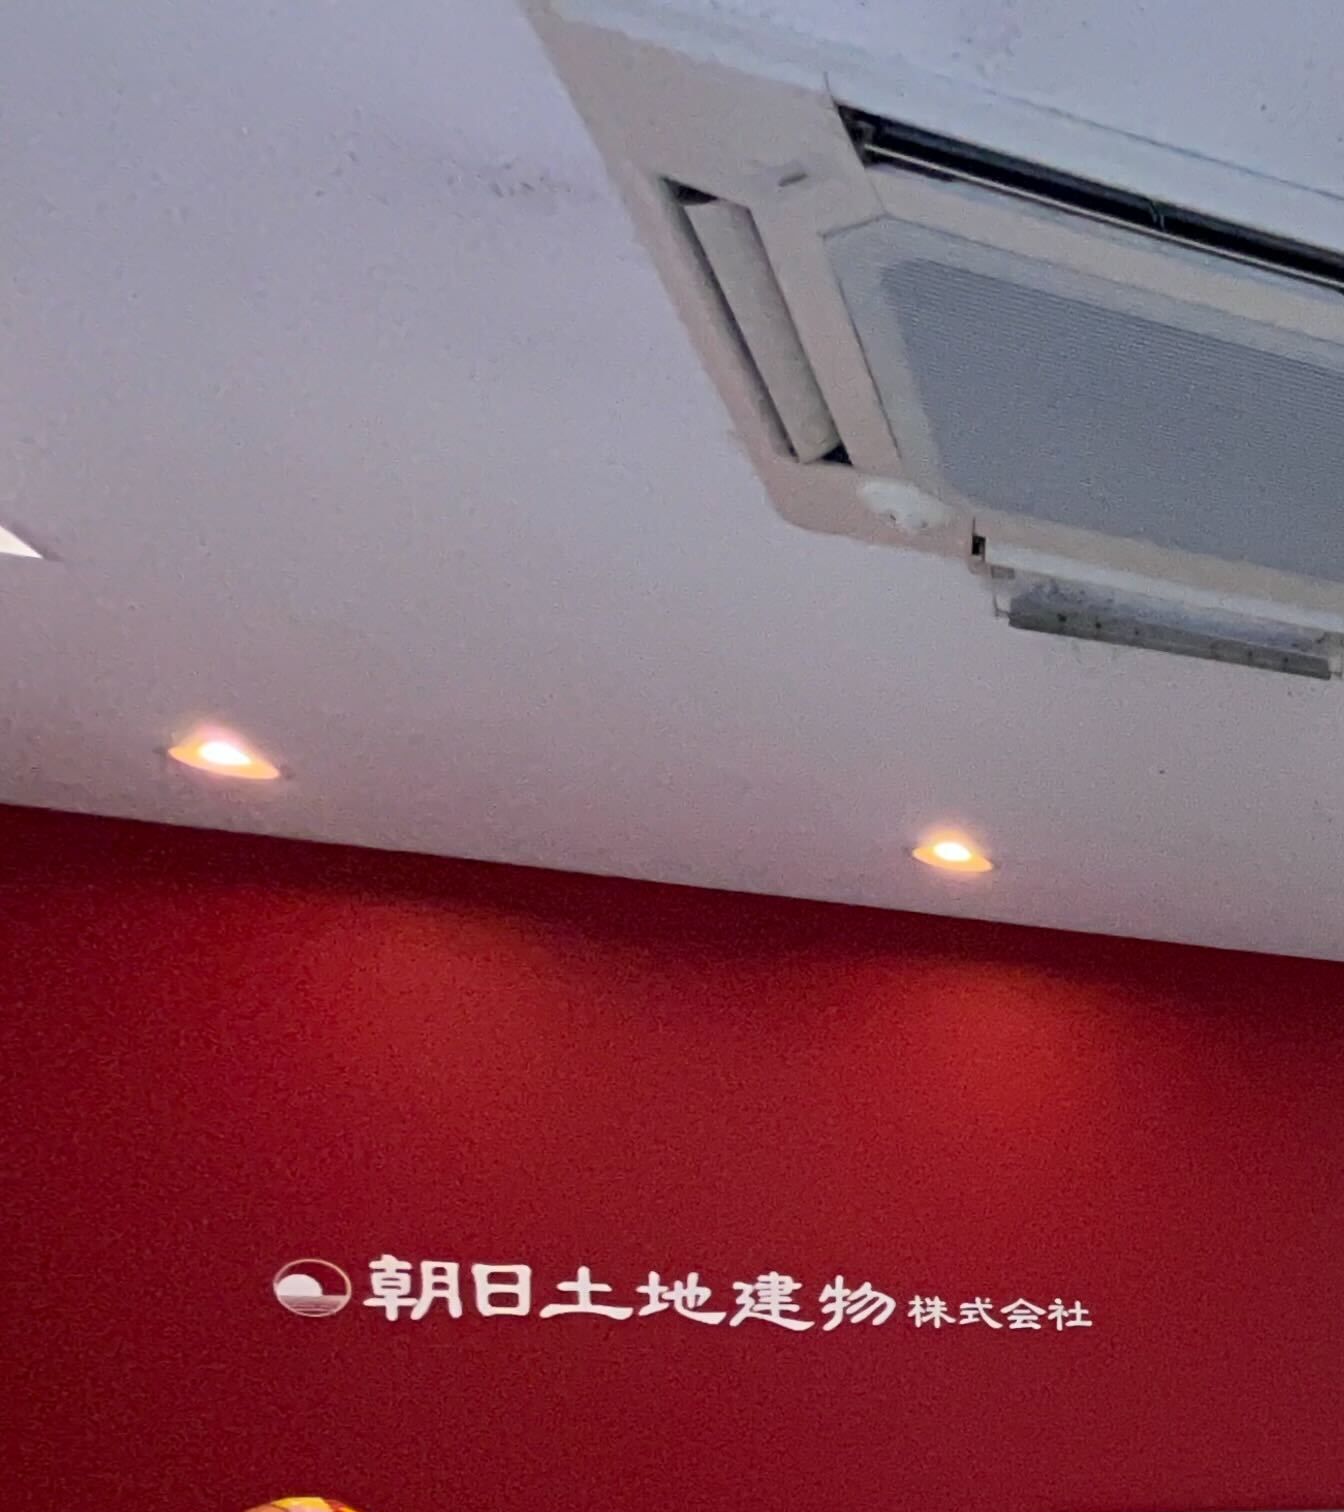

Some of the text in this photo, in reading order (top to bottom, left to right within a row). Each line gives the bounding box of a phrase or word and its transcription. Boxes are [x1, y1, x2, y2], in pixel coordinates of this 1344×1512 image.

[364, 1253, 1094, 1332] 朝日土地建物 株式会社
